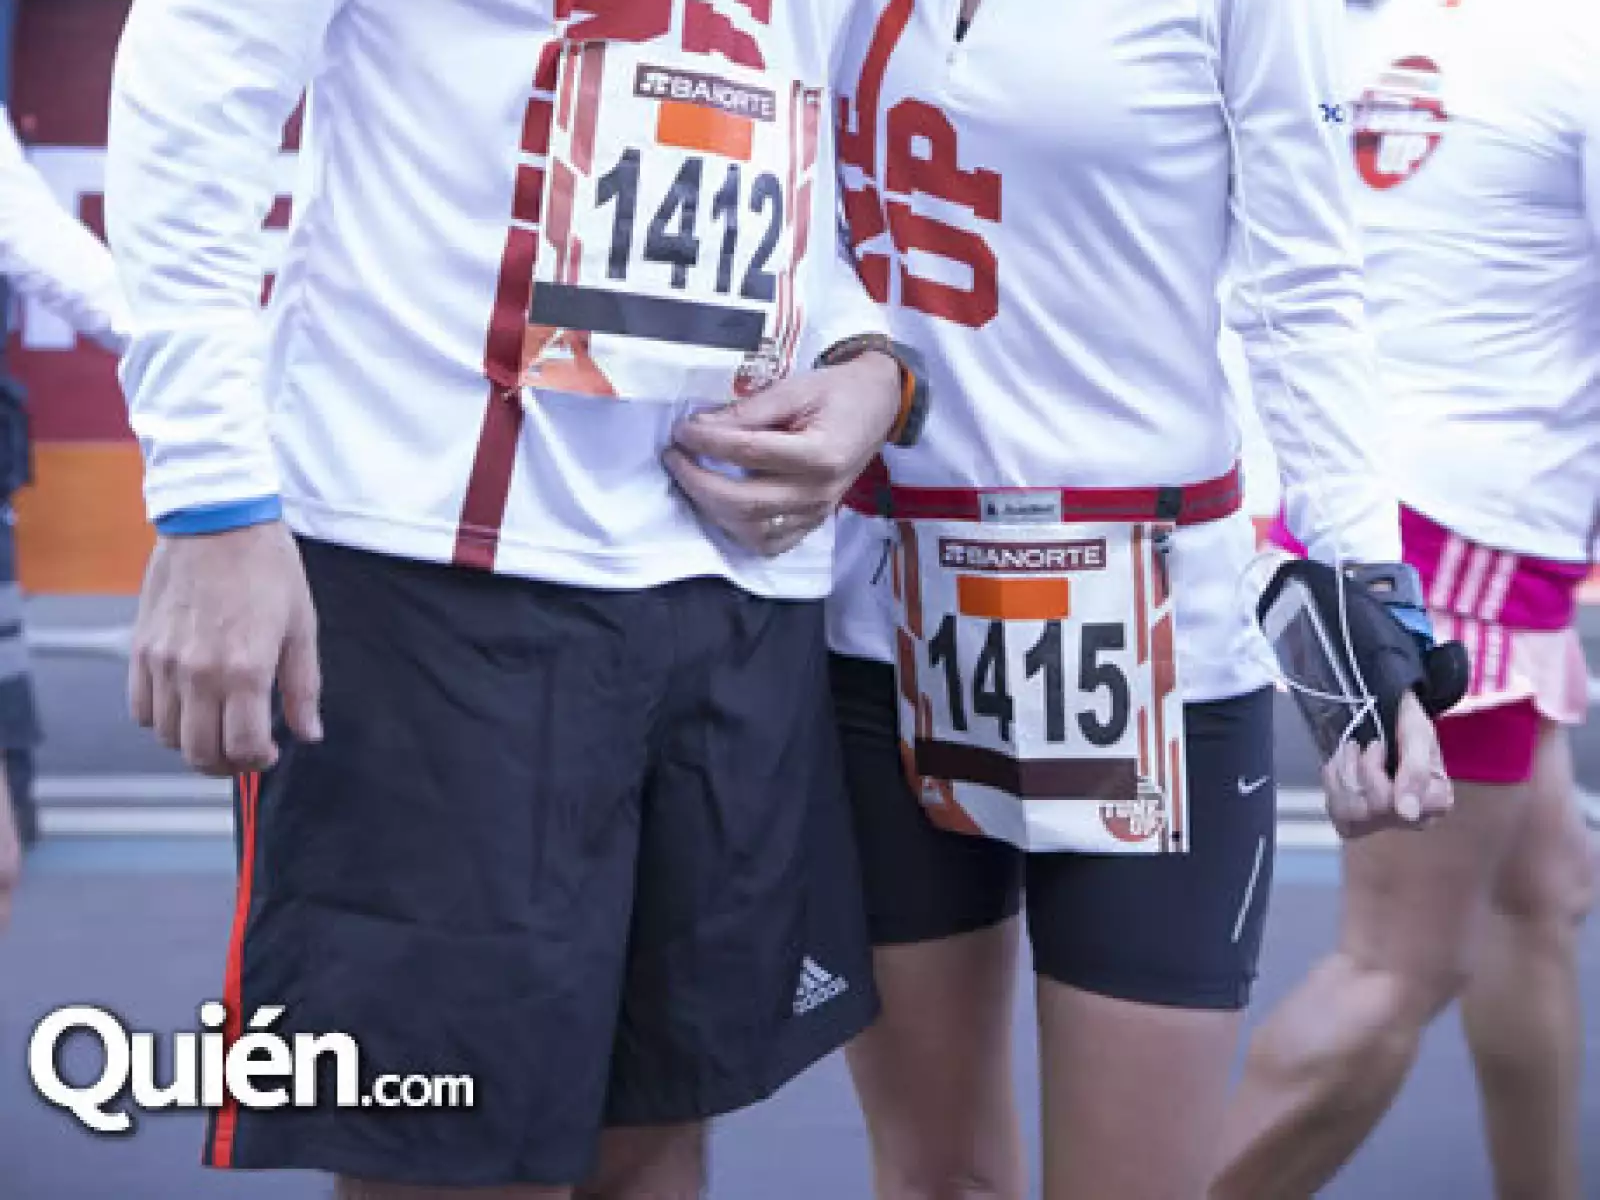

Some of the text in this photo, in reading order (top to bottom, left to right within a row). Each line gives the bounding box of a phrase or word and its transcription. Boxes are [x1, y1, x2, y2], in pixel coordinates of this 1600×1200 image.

[595, 147, 783, 302] 1412
[886, 98, 1002, 328] UP
[929, 614, 1128, 746] 1415
